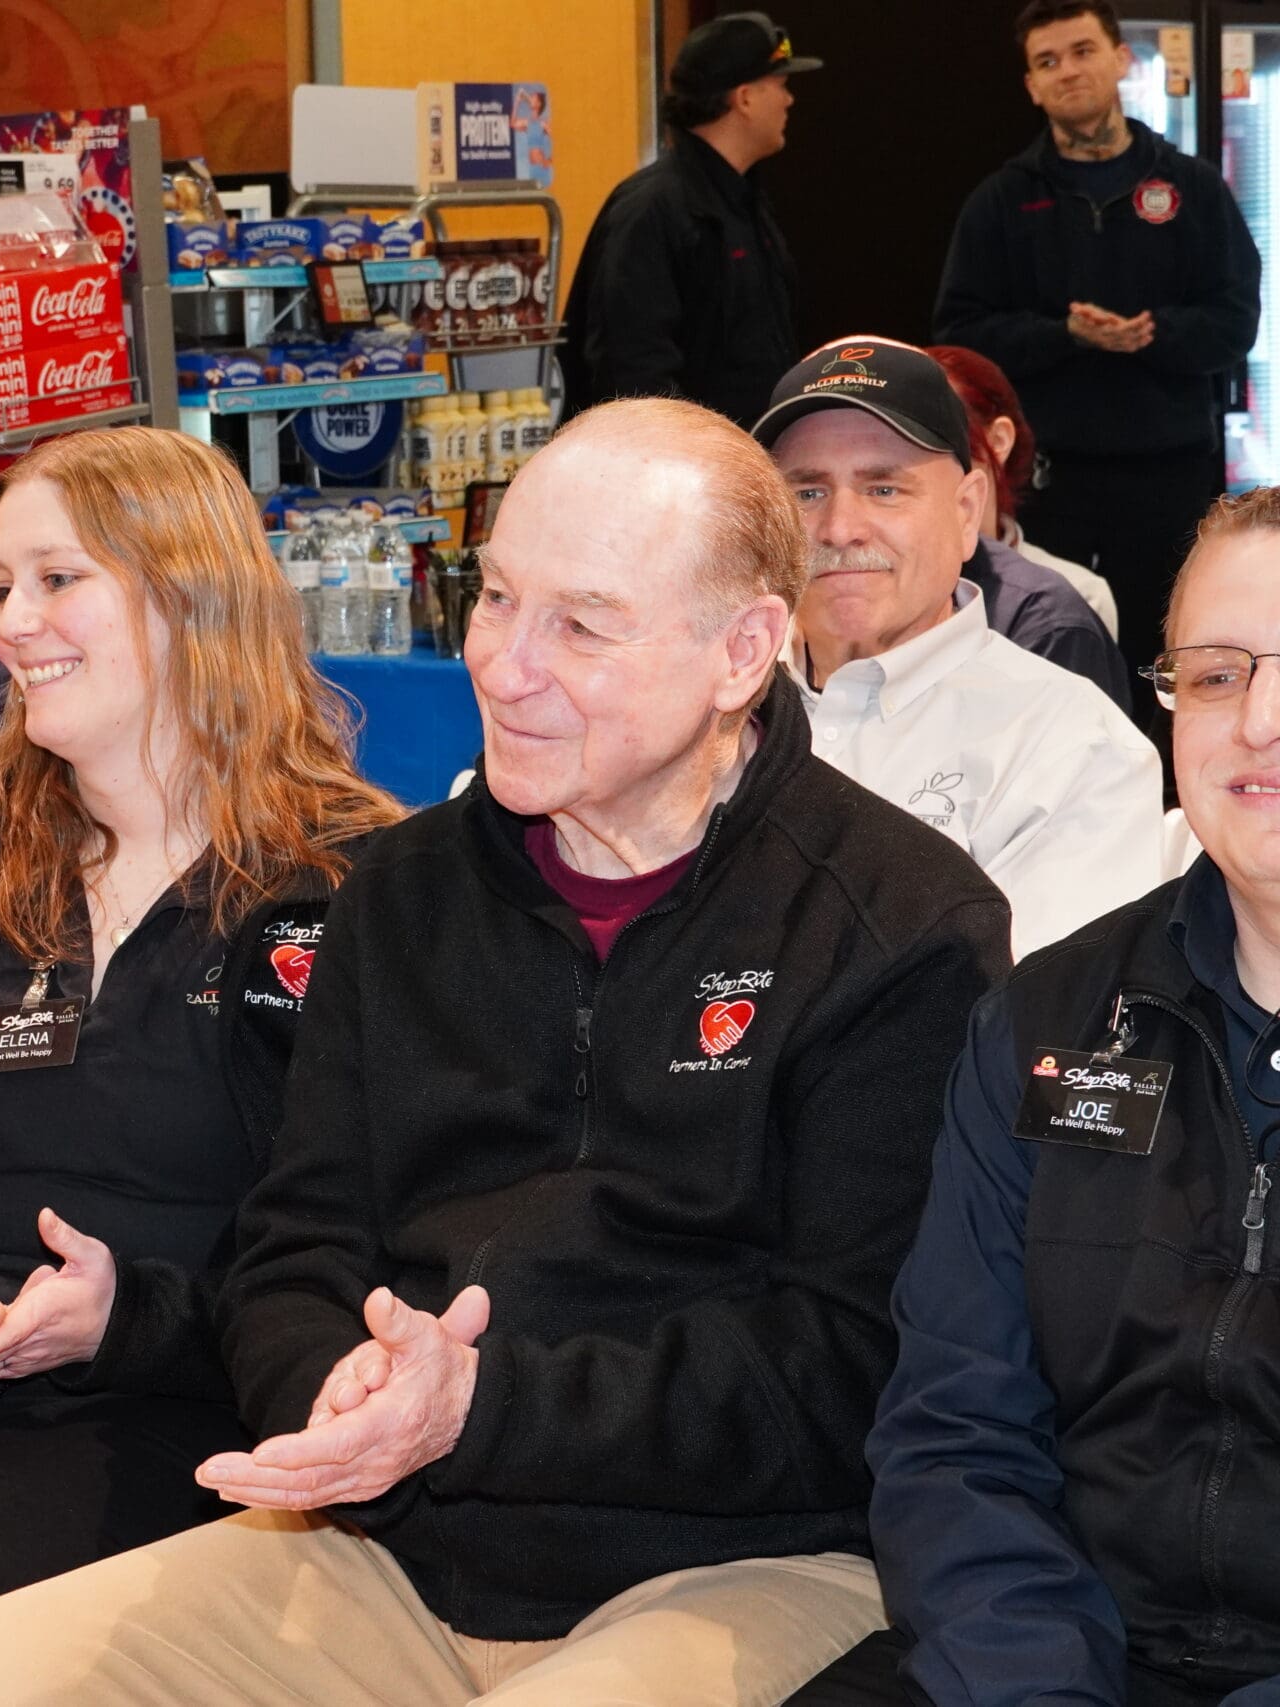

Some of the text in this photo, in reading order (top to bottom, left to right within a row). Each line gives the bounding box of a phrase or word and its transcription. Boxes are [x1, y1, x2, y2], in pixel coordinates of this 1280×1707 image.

[460, 114, 511, 147] PROTEIN
[31, 277, 107, 326] Coca-Cola
[38, 349, 115, 397] Coca-Cola
[843, 375, 888, 388] FAMILY
[327, 418, 371, 438] POWER
[694, 969, 776, 1001] ShopRite
[244, 989, 294, 1010] Partners
[0, 1011, 54, 1032] ShopRite
[6, 1051, 20, 1060] Well
[21, 1050, 29, 1058] Be
[30, 1048, 53, 1059] Happy
[708, 1057, 722, 1071] In
[1061, 1068, 1131, 1091] ShopRite
[1068, 1100, 1112, 1121] JOE
[1050, 1116, 1125, 1137] Eat Well Be Happy
